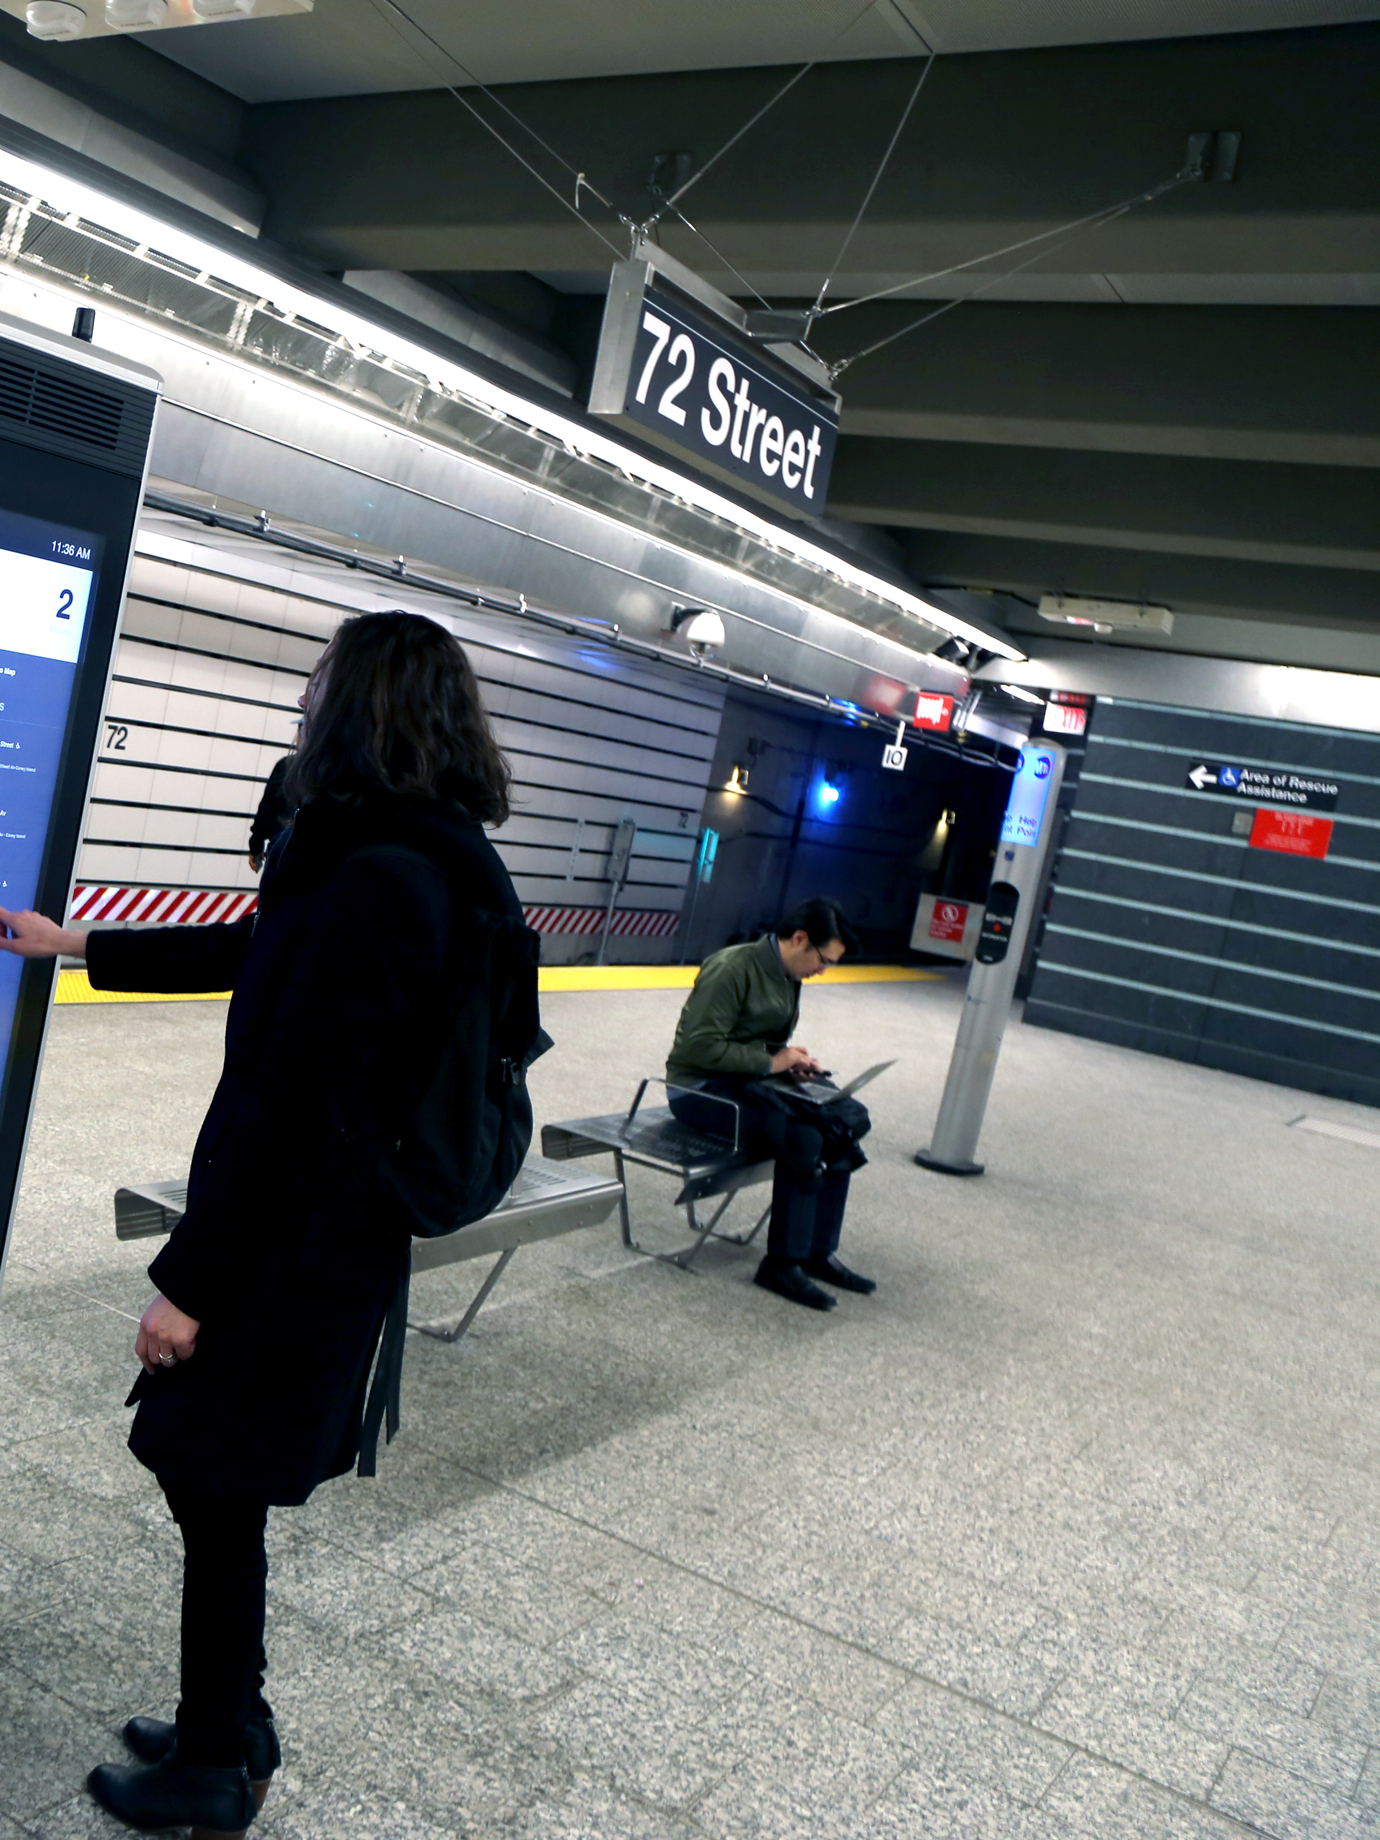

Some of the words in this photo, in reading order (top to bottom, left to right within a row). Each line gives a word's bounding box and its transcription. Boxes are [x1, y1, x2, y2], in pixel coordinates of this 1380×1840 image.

[635, 310, 696, 427] 72
[700, 356, 822, 499] Street
[51, 540, 76, 557] 11:36
[76, 546, 92, 560] AM
[55, 588, 74, 620] 2
[4, 667, 16, 677] Map
[0, 740, 14, 748] Street
[106, 724, 129, 750] 72
[1239, 768, 1270, 784] Area
[1272, 774, 1288, 788] of
[1289, 776, 1338, 796] Rescue
[1236, 782, 1308, 804] Assistance
[1018, 814, 1038, 827] Help
[1016, 826, 1037, 838] Point
